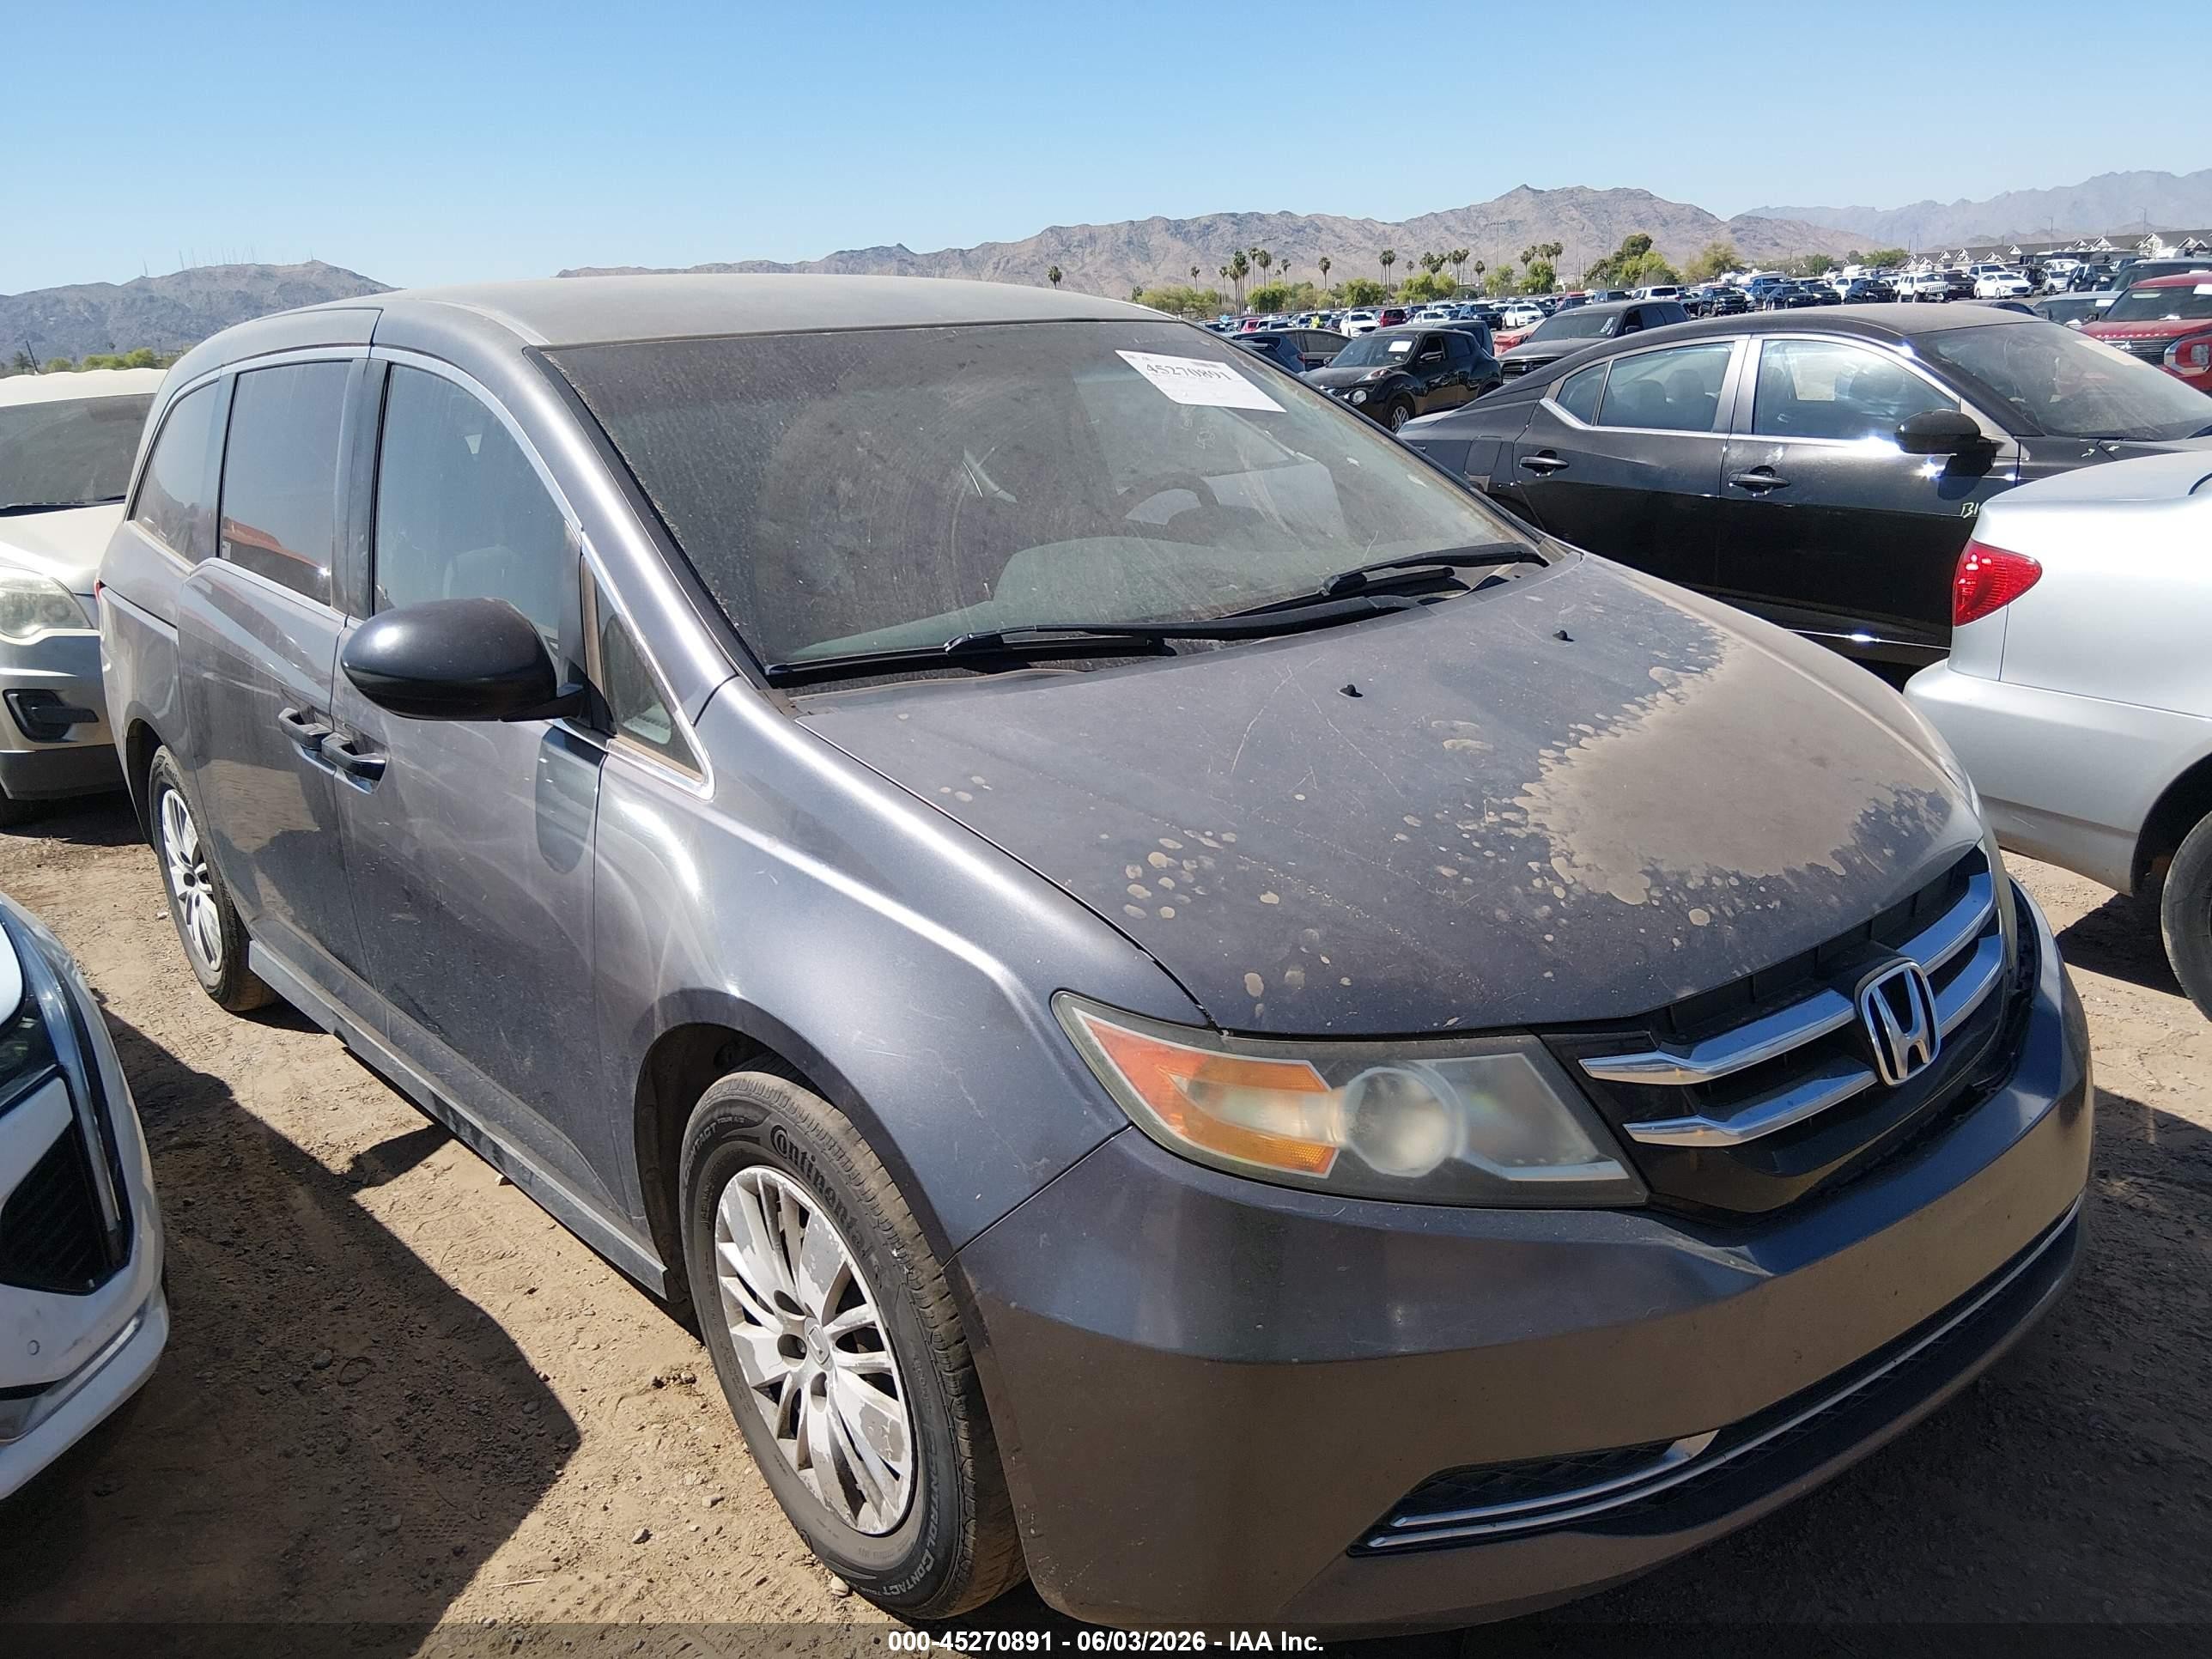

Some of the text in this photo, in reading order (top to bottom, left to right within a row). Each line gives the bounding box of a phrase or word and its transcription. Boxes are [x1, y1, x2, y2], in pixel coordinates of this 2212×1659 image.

[1146, 363, 1231, 381] 45270891
[770, 1124, 874, 1260] Continental
[882, 1548, 935, 1596] CONTACT
